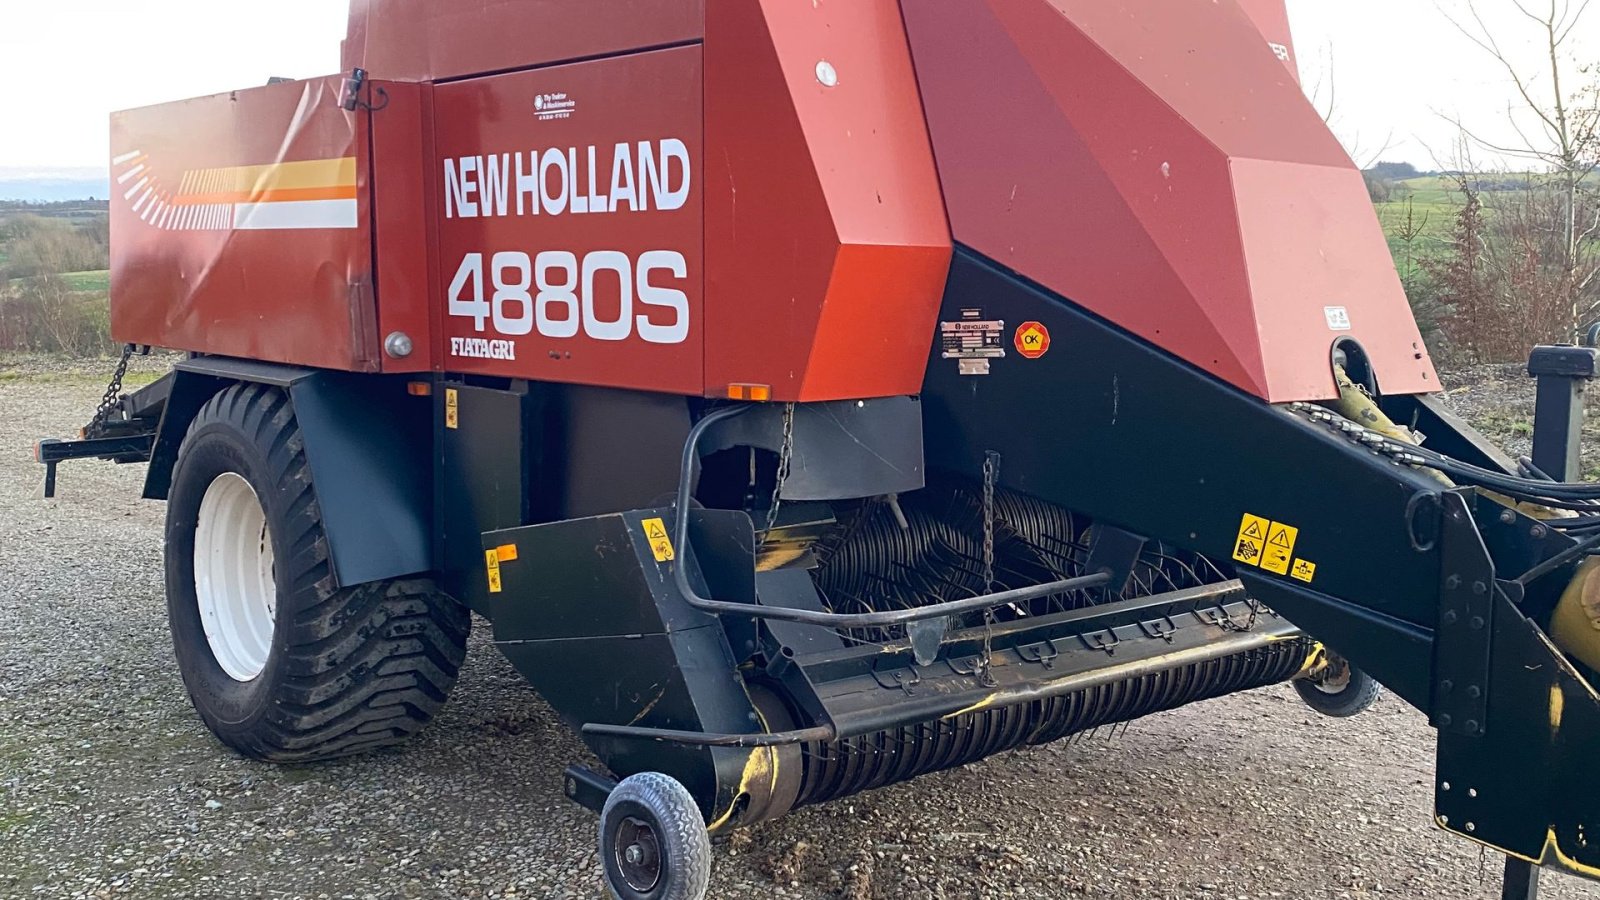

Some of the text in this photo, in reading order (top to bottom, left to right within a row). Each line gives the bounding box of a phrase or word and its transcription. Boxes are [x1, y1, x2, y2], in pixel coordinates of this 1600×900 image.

[443, 138, 691, 218] NEW HOLLAND
[448, 250, 690, 344] 4880S
[450, 337, 516, 361] FIATAGRI
[1024, 335, 1038, 344] OK
